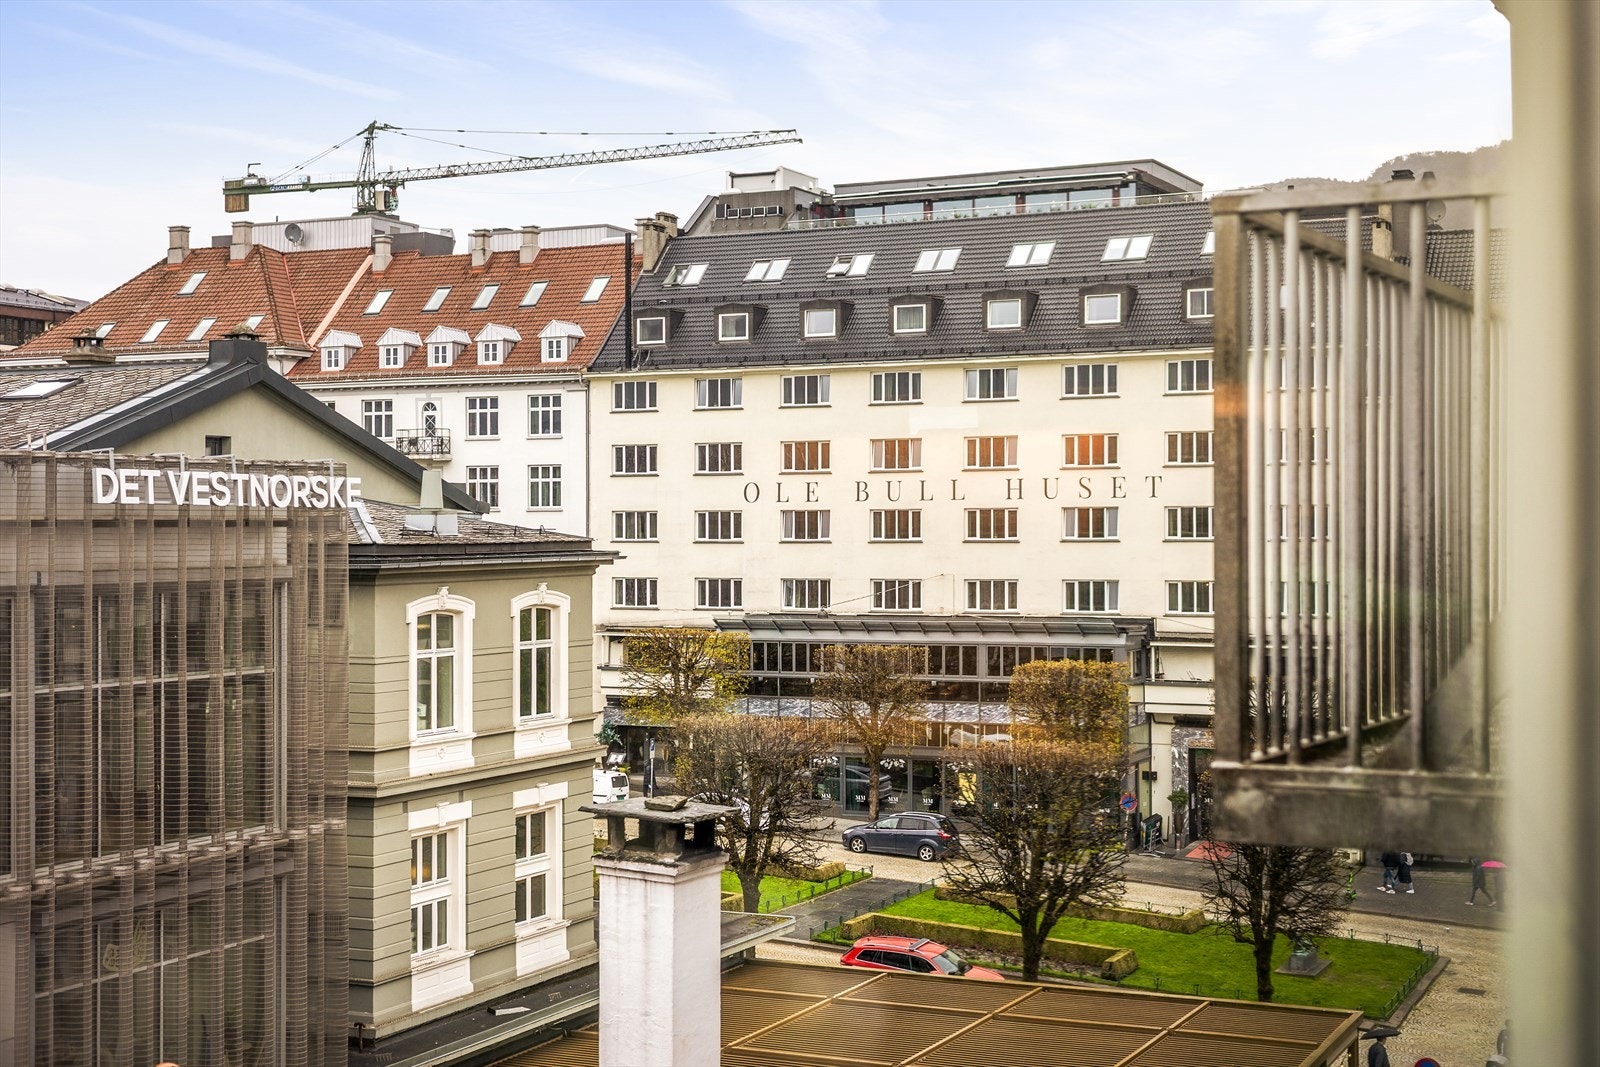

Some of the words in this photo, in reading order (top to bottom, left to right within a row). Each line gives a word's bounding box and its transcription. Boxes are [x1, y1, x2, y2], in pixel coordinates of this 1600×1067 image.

[92, 467, 160, 505] DET
[167, 470, 362, 508] VESTNORSKE
[743, 481, 820, 503] OLE
[854, 478, 966, 502] BULL
[1005, 475, 1164, 500] HUSET
